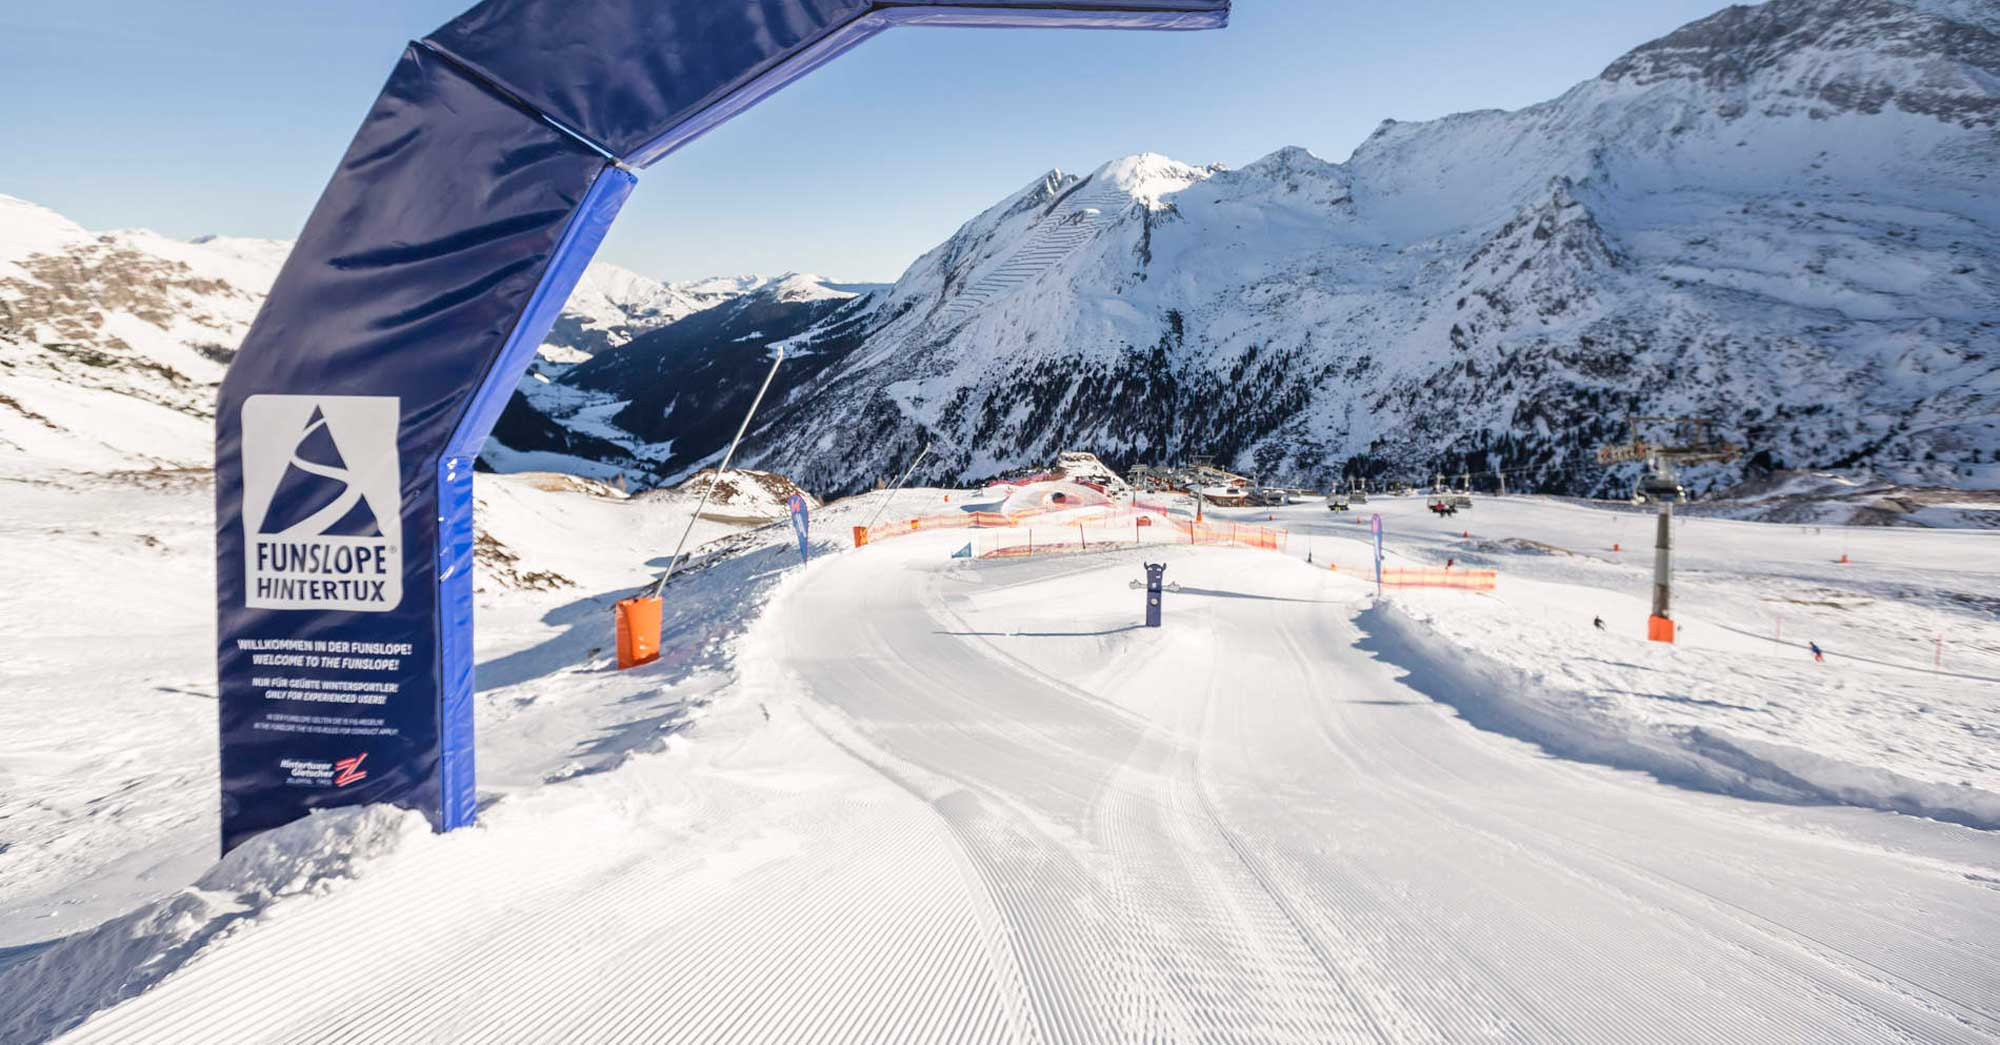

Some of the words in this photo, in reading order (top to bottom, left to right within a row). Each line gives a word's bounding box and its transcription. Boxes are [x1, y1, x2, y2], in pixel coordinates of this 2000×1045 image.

[257, 543, 386, 574] FUNSLOPE
[257, 577, 385, 602] HINTERTUX
[237, 639, 313, 651] WILLKOMMEN
[314, 640, 327, 652] IN
[328, 641, 350, 653] DER
[351, 642, 413, 655] FUNSLOPE!
[252, 654, 305, 667] WELCOME
[305, 656, 320, 667] TO
[321, 656, 342, 668] THE
[342, 658, 400, 670] FUNSLOPE!
[252, 677, 271, 687] NUR
[265, 689, 288, 699] ONLY
[287, 690, 304, 700] FOR
[303, 691, 357, 703] EXPERIENCED
